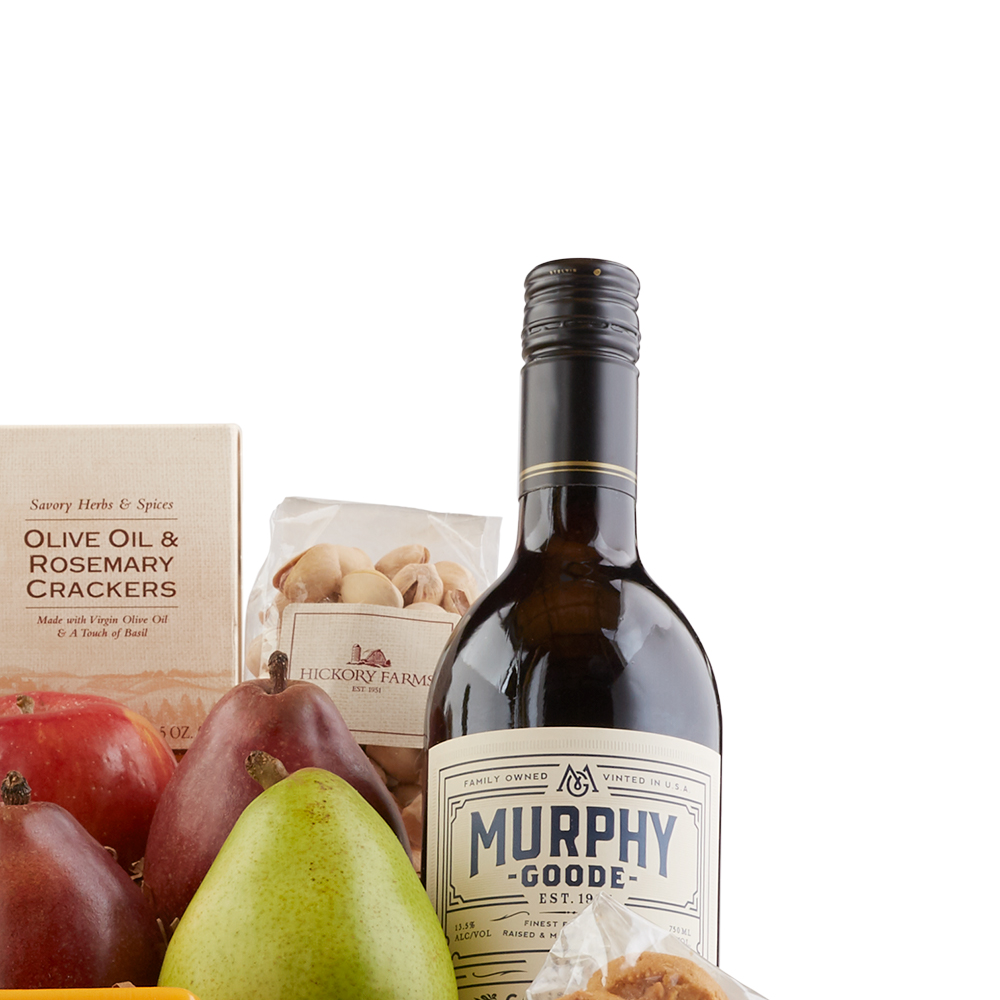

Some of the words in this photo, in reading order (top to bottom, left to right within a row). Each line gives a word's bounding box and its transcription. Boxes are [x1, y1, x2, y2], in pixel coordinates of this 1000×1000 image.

[30, 498, 72, 514] Savory
[78, 498, 113, 511] Herbs
[119, 498, 131, 511] &
[137, 498, 174, 514] Spices
[24, 528, 100, 549] OLIVE
[109, 528, 153, 549] OIL
[161, 531, 178, 548] &
[30, 554, 174, 574] ROSEMARY
[26, 579, 177, 599] CRACKERS
[37, 615, 63, 625] Made
[67, 615, 86, 625] with
[90, 615, 118, 627] Virgin
[122, 615, 148, 625] Olive
[152, 614, 168, 624] Oil
[57, 628, 66, 638] &
[69, 628, 78, 638] A
[81, 628, 107, 638] Touch
[111, 628, 122, 640] of
[124, 628, 148, 638] Basil
[299, 667, 377, 684] HICKORY
[170, 726, 194, 740] OZ.
[464, 775, 500, 788] FAMILY
[505, 772, 547, 783] OWNED
[603, 773, 645, 785] VINTED
[650, 778, 660, 787] IN
[665, 781, 691, 794] U.S.A.
[470, 805, 678, 880] MURPHY
[539, 893, 574, 905] EST.
[455, 920, 475, 932] 13.5%
[524, 919, 558, 928] FINEST
[455, 929, 491, 942] ALC/VOL
[503, 929, 535, 939] RAISED
